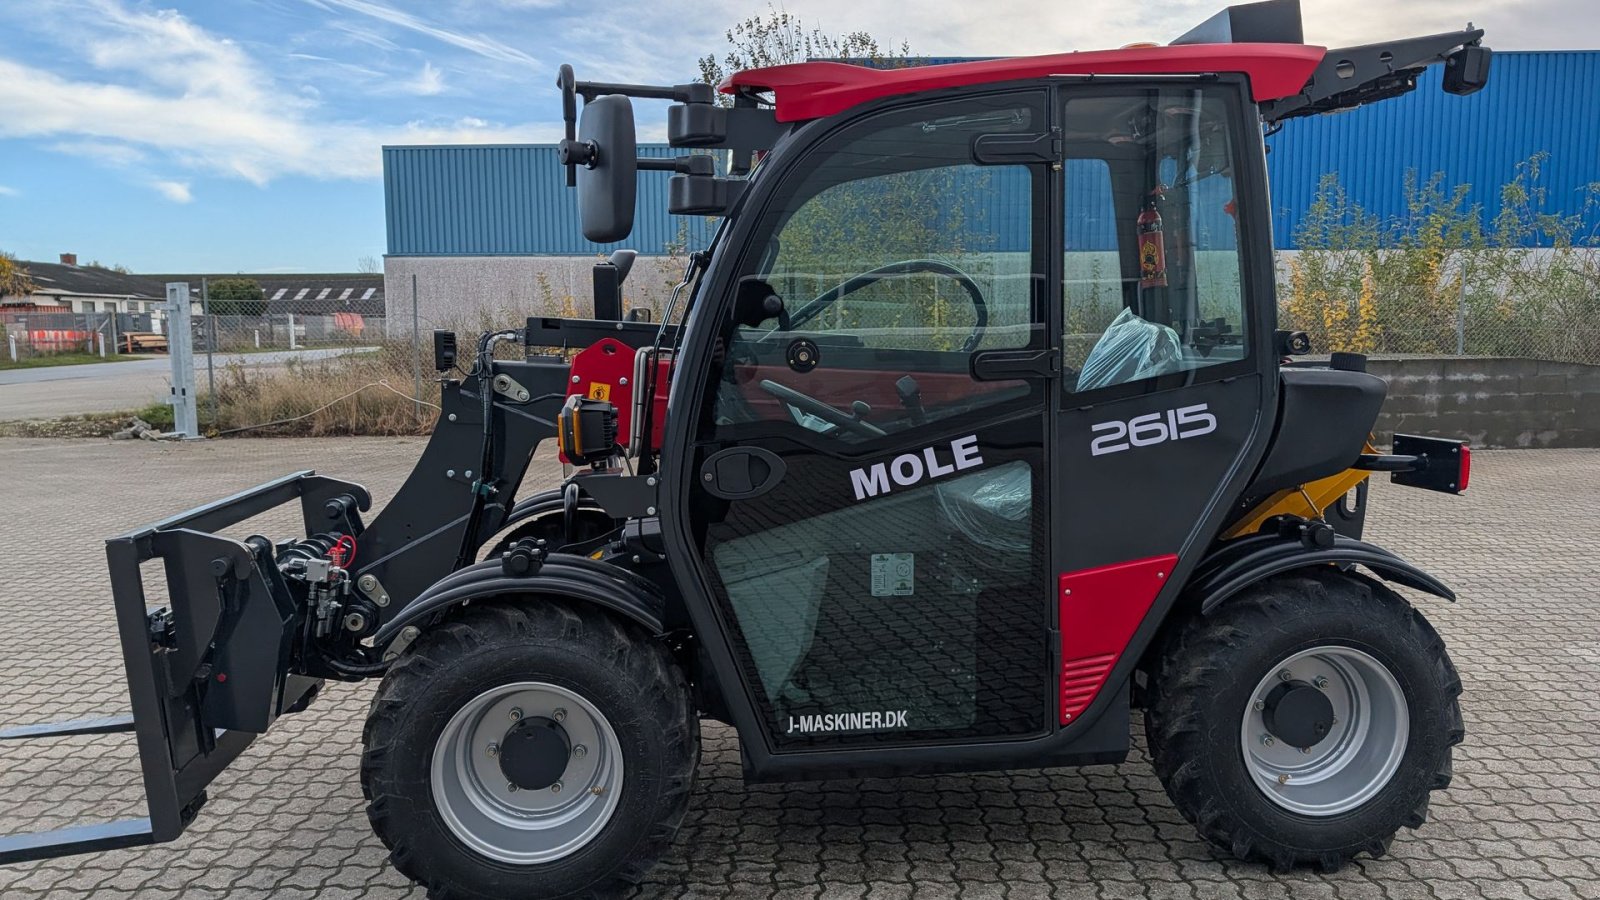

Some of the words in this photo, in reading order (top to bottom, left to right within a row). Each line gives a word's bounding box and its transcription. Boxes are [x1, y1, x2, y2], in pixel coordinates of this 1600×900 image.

[1091, 403, 1217, 456] 2615
[849, 434, 984, 500] MOLE
[787, 710, 908, 734] J-MASKINER.DK
